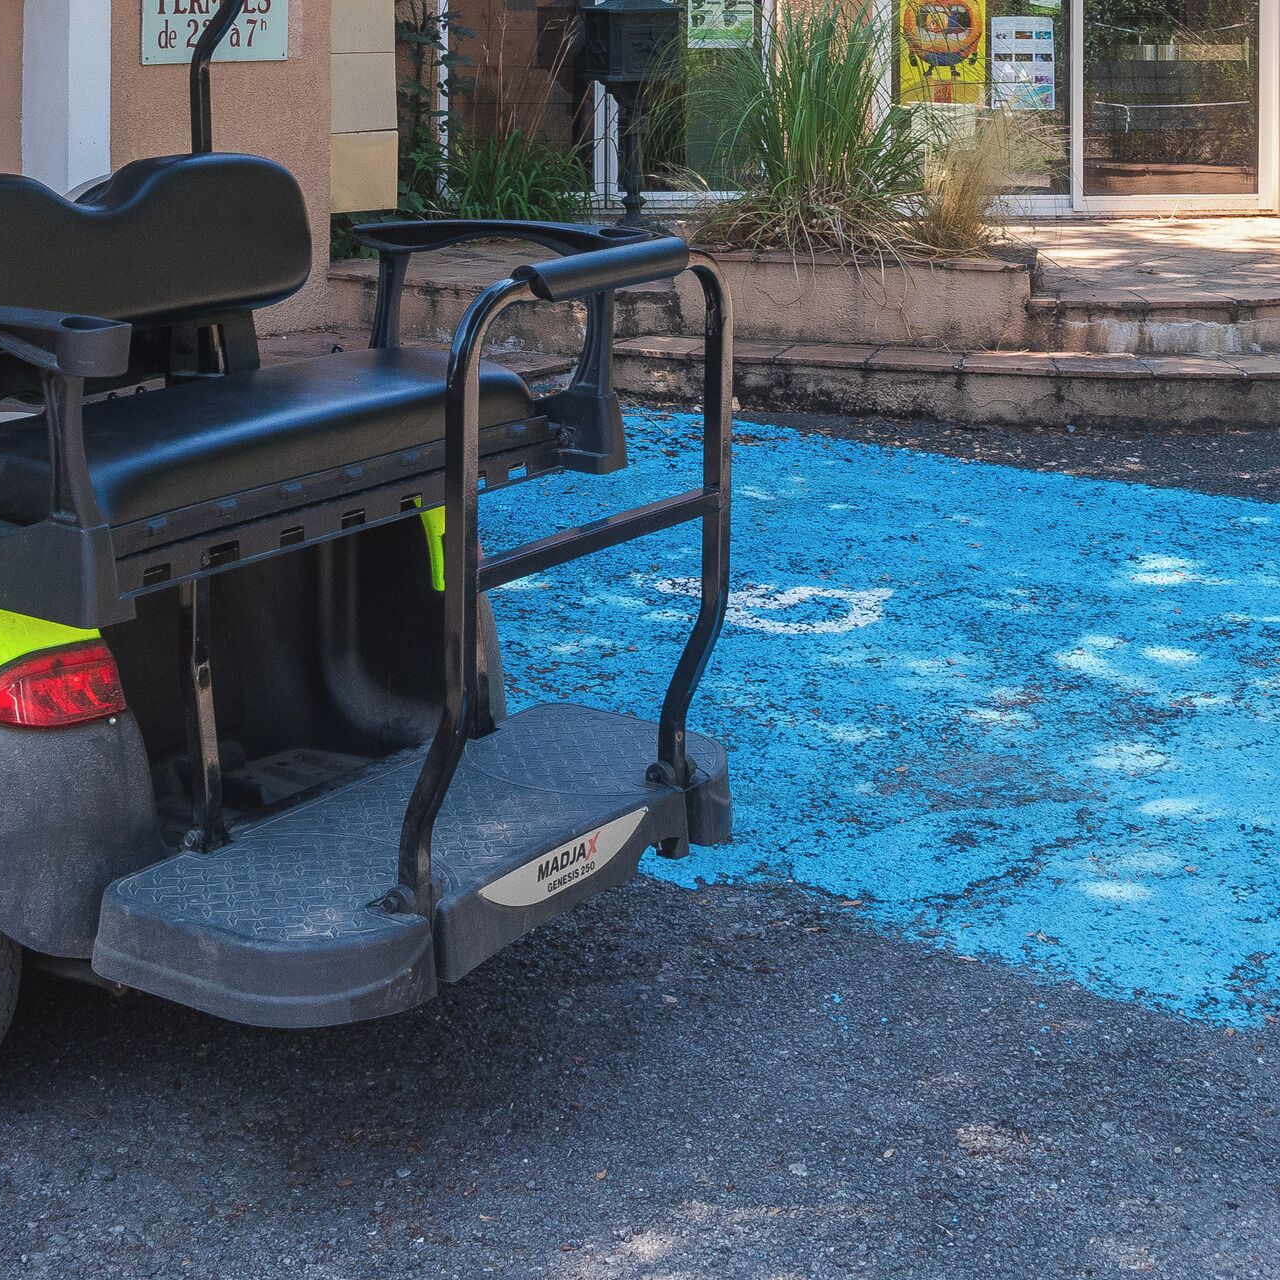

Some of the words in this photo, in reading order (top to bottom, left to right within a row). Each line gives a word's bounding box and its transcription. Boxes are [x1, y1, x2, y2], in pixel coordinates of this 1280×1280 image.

[158, 20, 177, 49] de
[229, 22, 241, 47] à
[536, 830, 601, 883] MADJAX
[547, 868, 580, 893] GENESIS
[580, 860, 596, 877] 250
